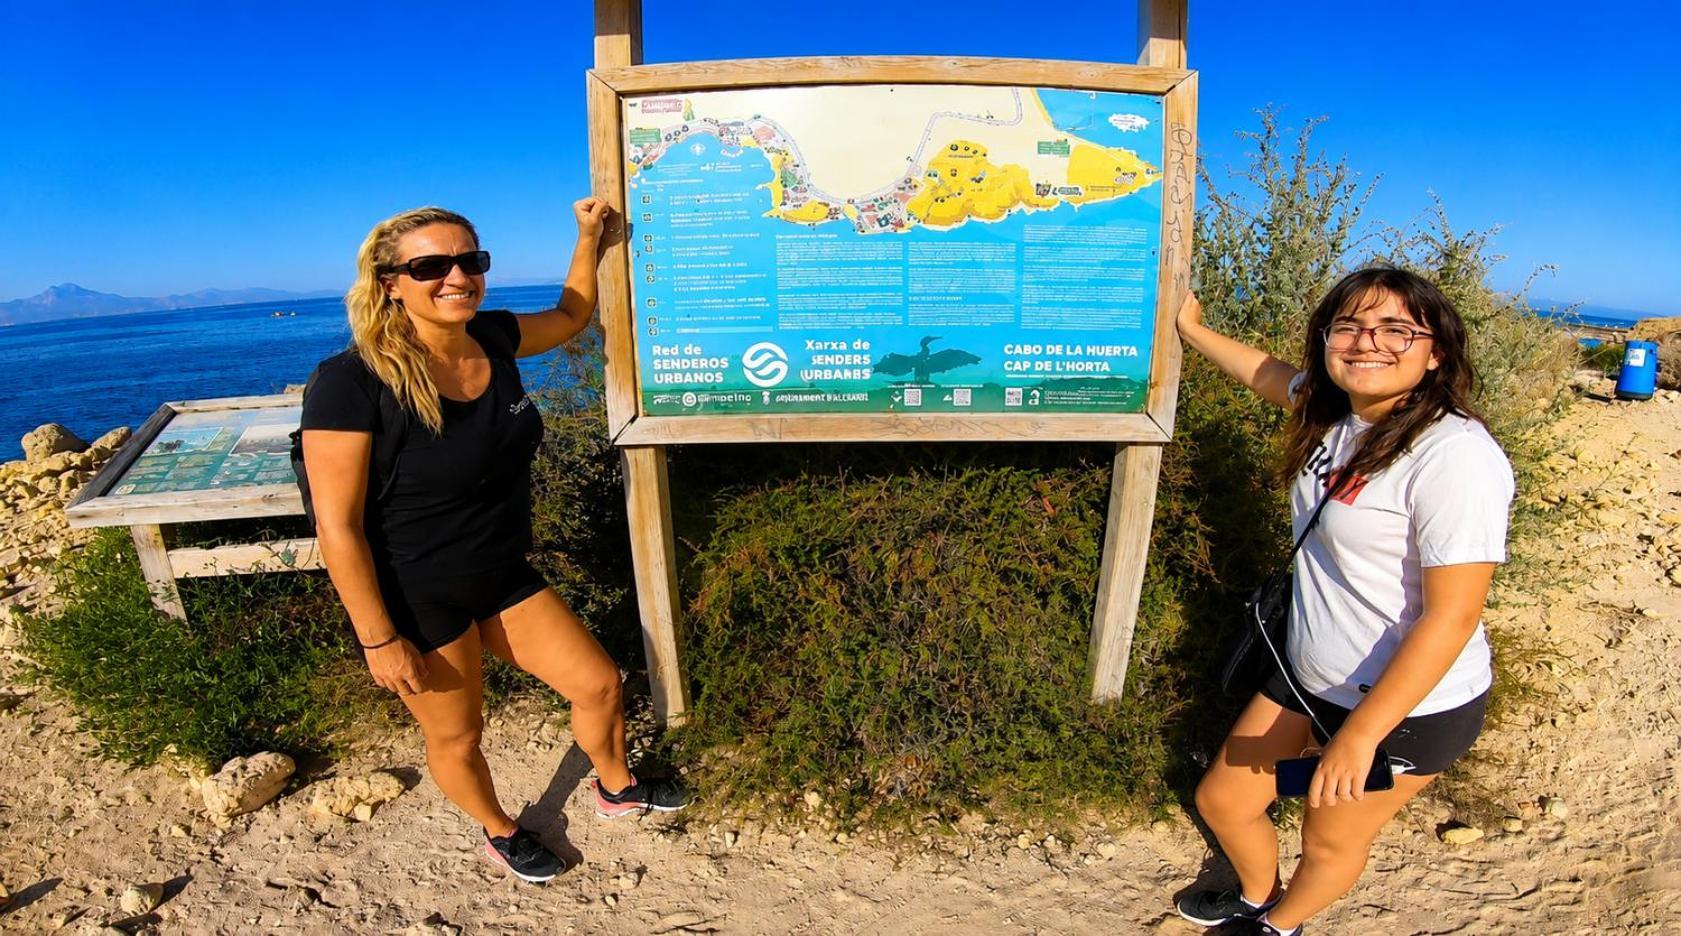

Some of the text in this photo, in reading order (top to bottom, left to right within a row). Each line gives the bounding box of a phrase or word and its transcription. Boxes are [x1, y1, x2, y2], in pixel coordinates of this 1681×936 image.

[652, 343, 702, 356] Red de
[805, 338, 871, 351] Xarxa de
[1003, 344, 1138, 357] CABO DE LA HUERTA
[653, 357, 729, 370] SENDEROS
[811, 353, 871, 365] SENDERS
[1003, 360, 1111, 372] CAP DE L'HORTA
[654, 371, 724, 384] URBANOS
